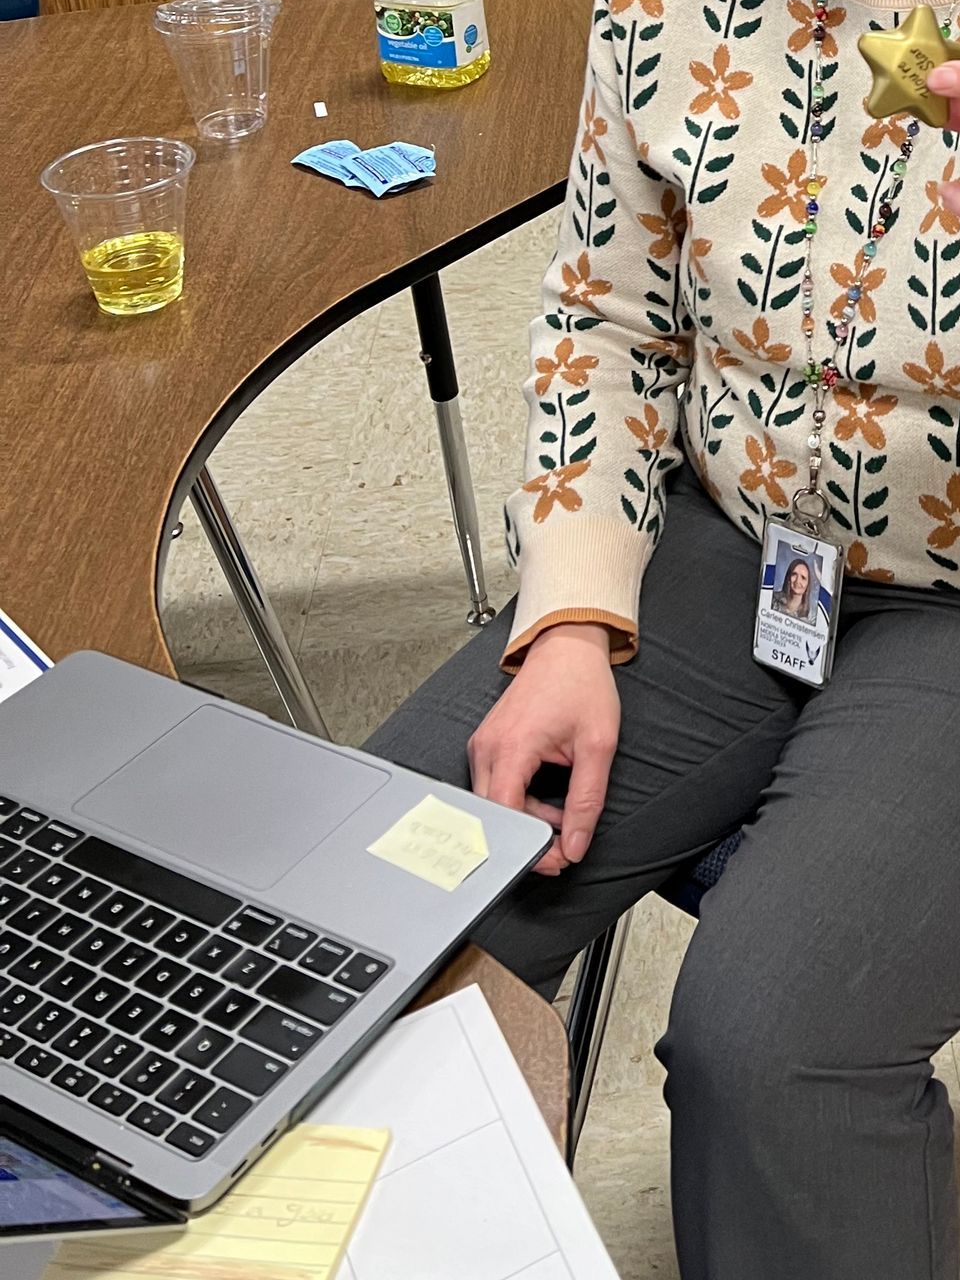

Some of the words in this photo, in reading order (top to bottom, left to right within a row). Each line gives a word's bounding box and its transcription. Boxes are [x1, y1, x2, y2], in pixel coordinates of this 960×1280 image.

[771, 648, 807, 671] STAFF
[175, 931, 188, 943] C
[90, 940, 103, 950] G
[208, 947, 222, 958] X
[241, 962, 256, 974] Z
[156, 971, 170, 982] D
[190, 986, 203, 998] S
[128, 1007, 142, 1018] E
[226, 1000, 240, 1013] A
[46, 1010, 59, 1021] 5
[160, 1023, 177, 1036] W
[113, 1044, 127, 1055] 3
[197, 1038, 212, 1052] Q
[148, 1061, 162, 1073] 2
